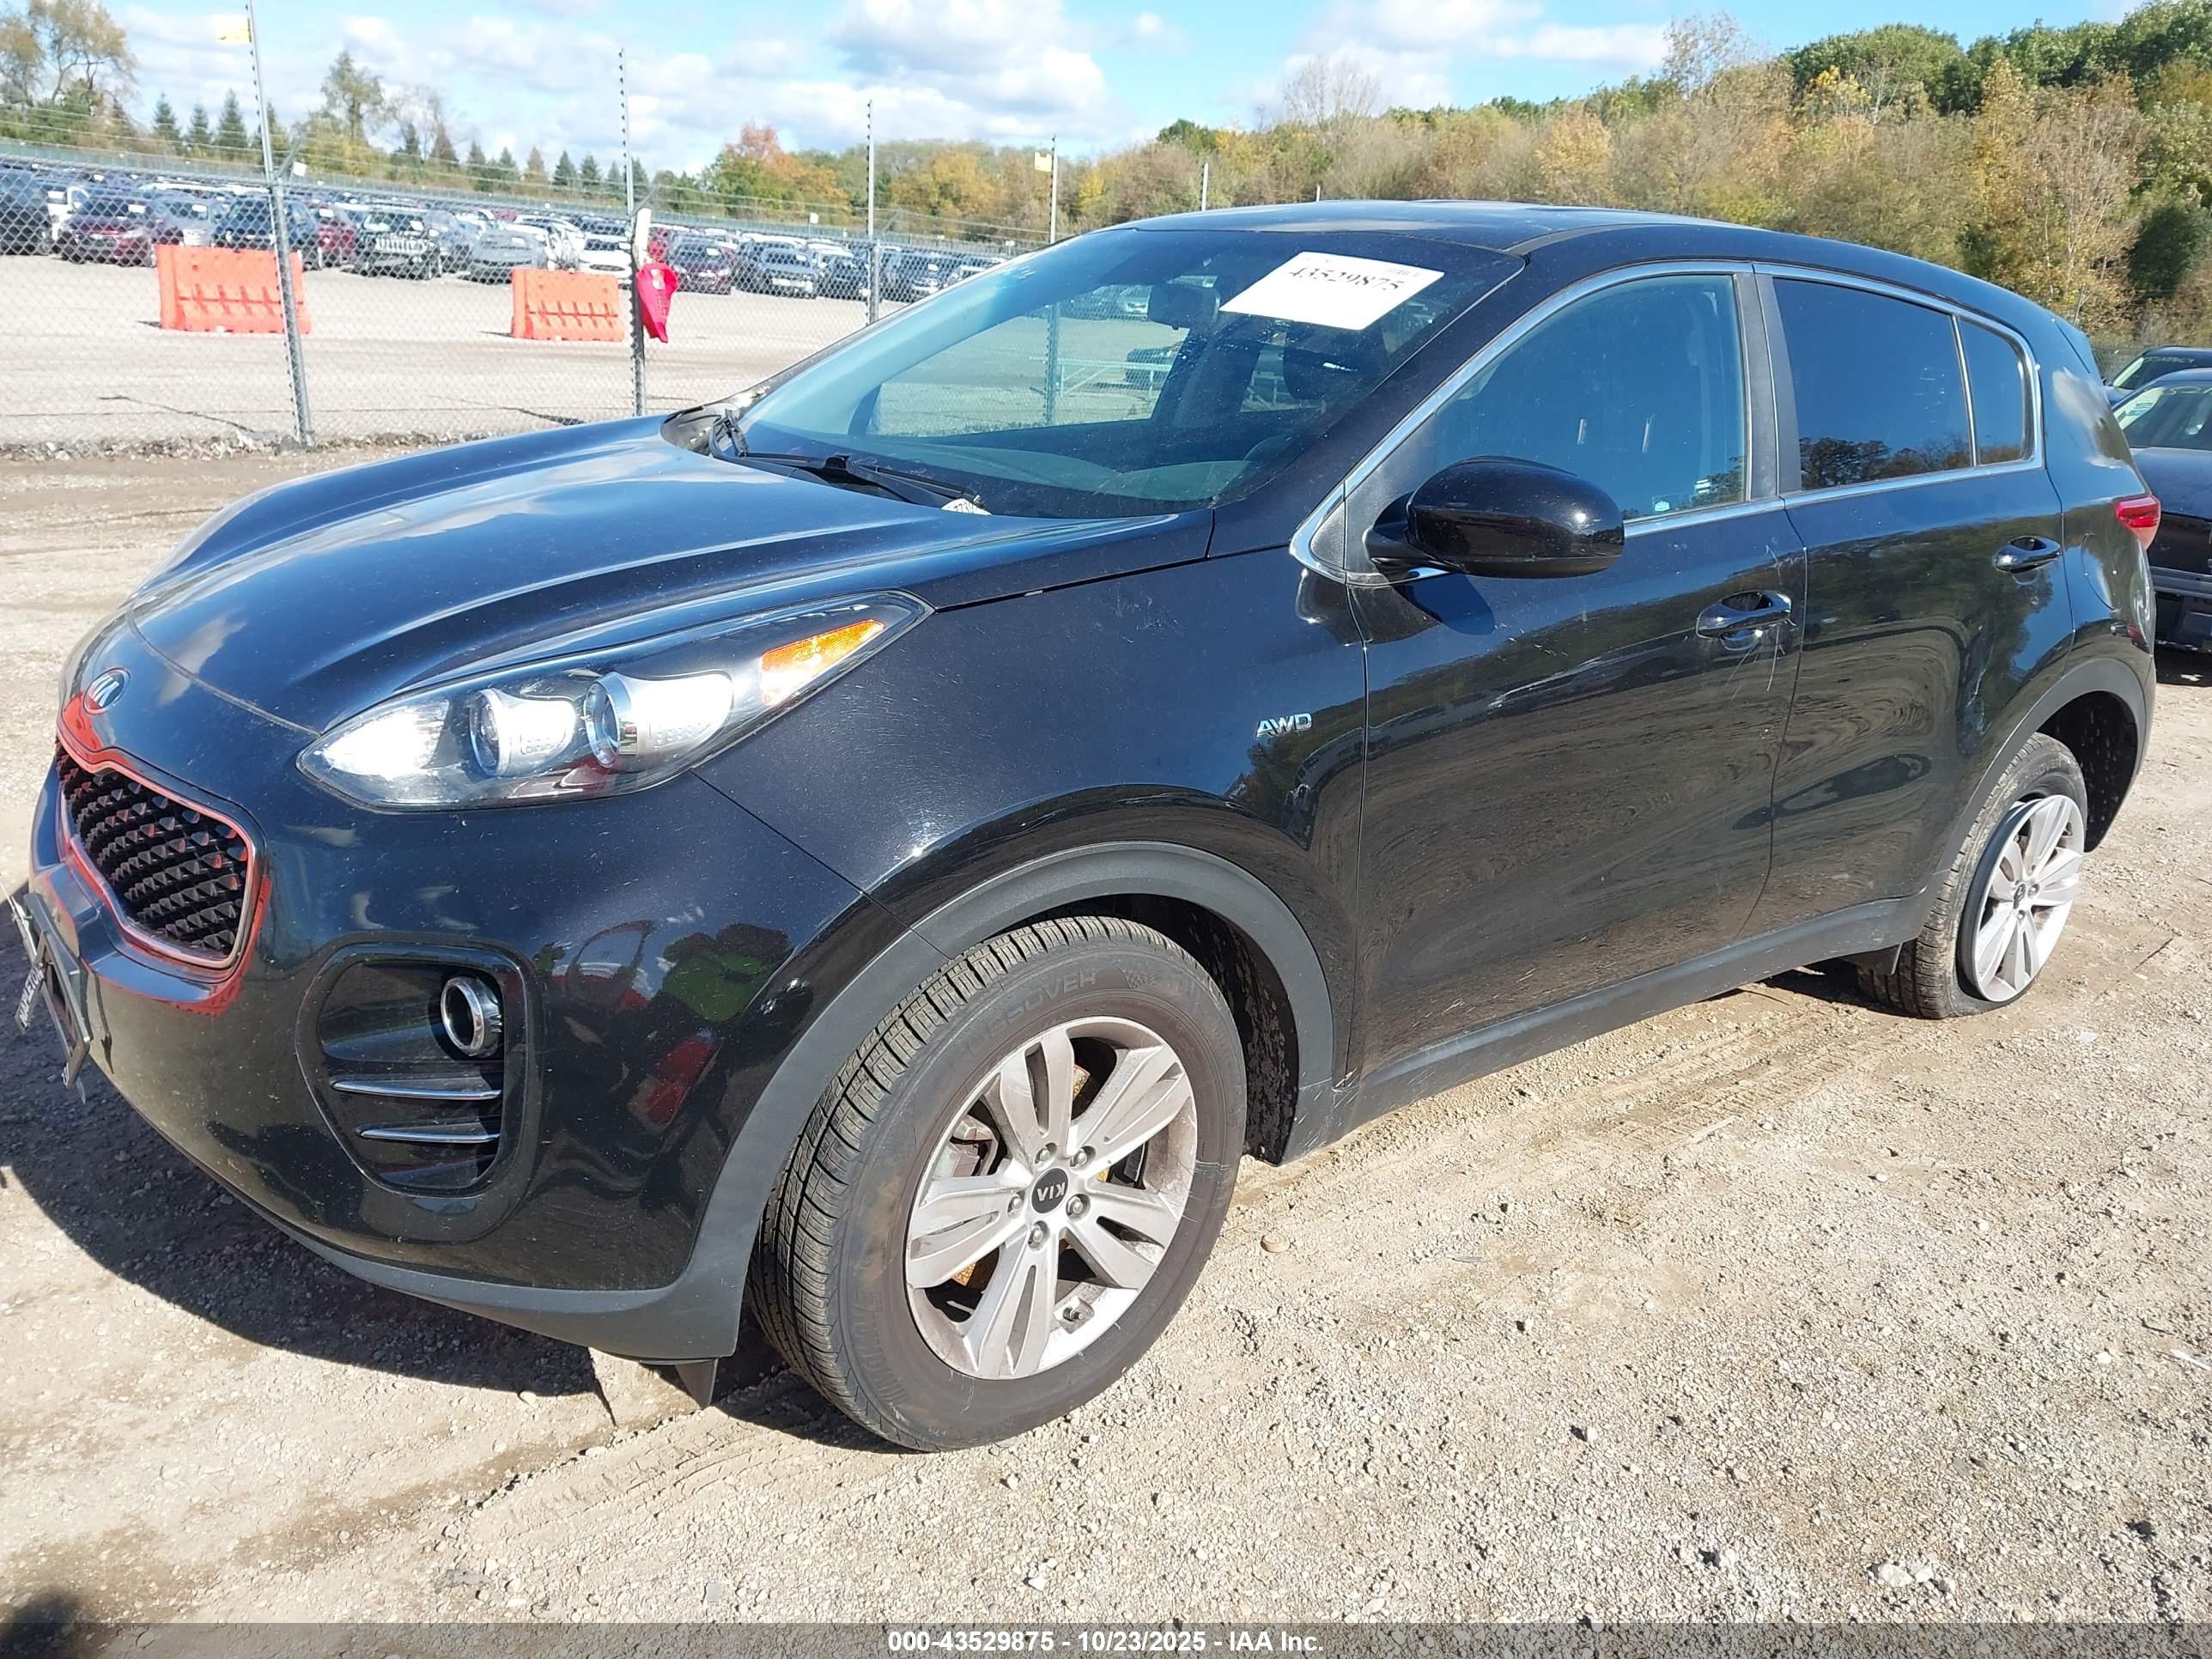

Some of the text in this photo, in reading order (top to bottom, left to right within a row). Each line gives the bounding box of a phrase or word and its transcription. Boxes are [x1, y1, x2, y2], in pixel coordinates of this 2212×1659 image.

[1288, 266, 1406, 291] 43529875
[1255, 713, 1312, 738] AWD
[1036, 1182, 1066, 1202] KIA
